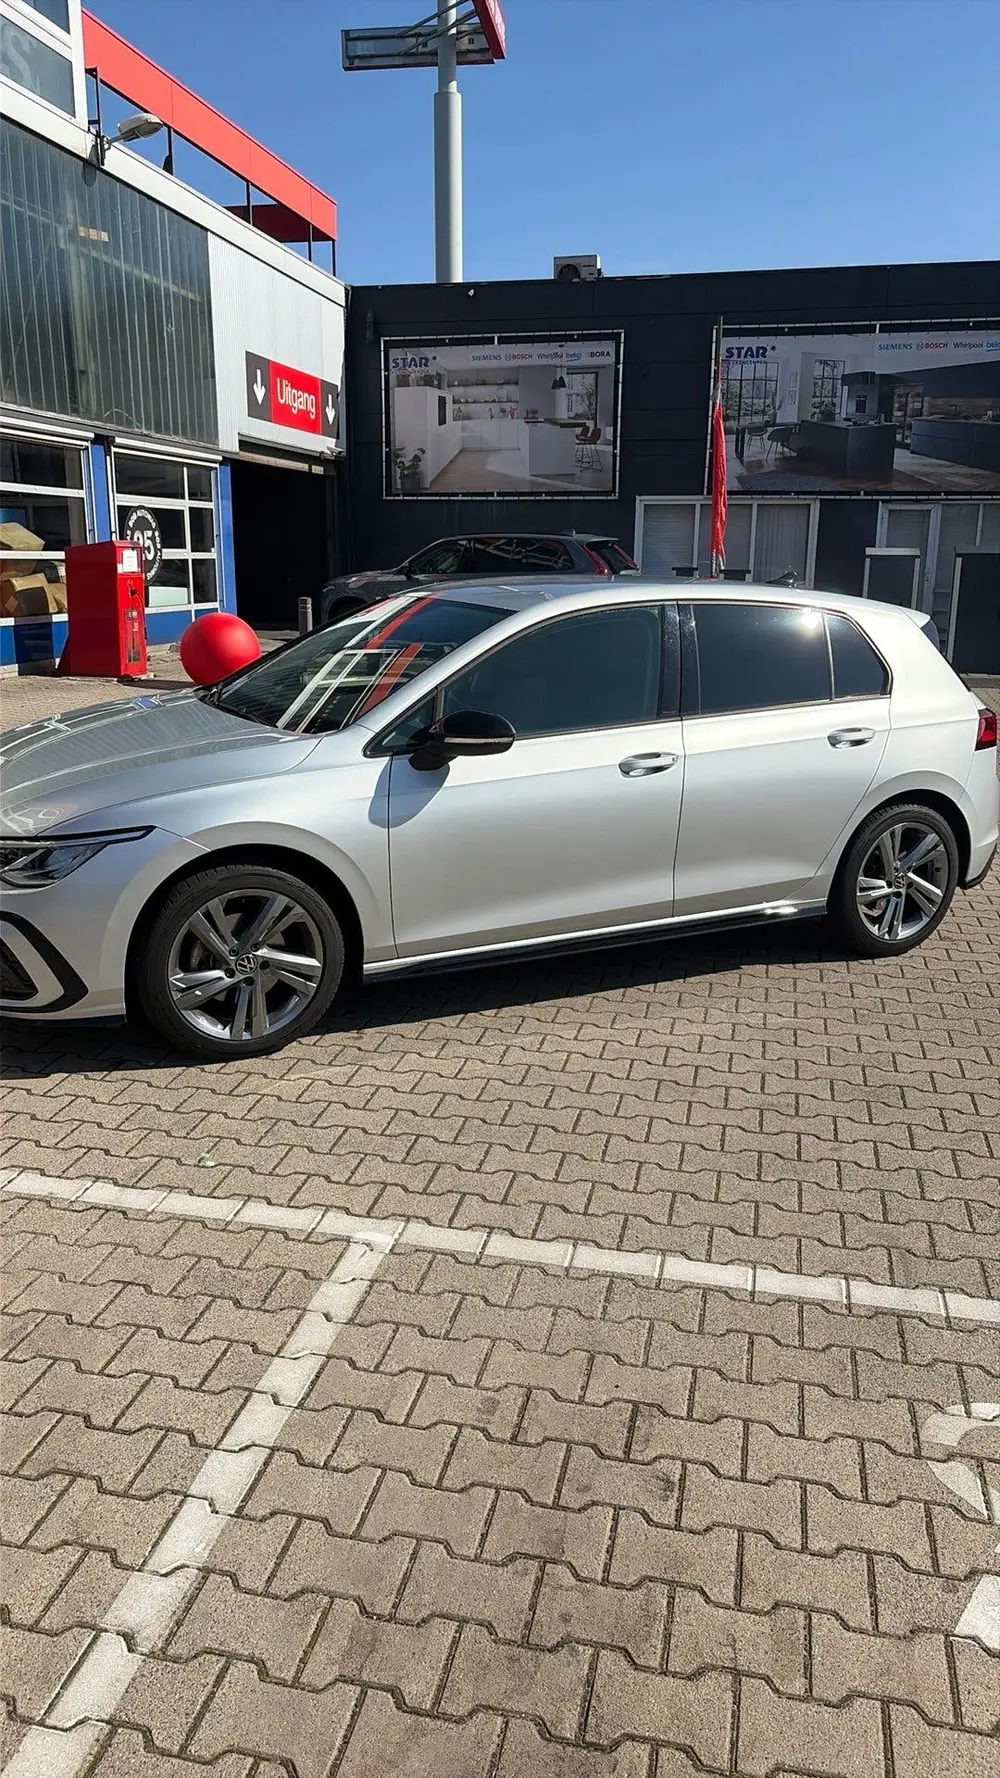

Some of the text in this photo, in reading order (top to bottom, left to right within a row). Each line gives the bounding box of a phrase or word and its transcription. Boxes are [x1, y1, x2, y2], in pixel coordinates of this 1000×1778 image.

[878, 343, 913, 351] SIEMENS
[953, 341, 984, 350] Whirlpool
[471, 354, 502, 362] SIEMENS
[725, 346, 768, 359] STAR
[392, 357, 430, 369] STAR
[277, 377, 316, 420] Uitgang
